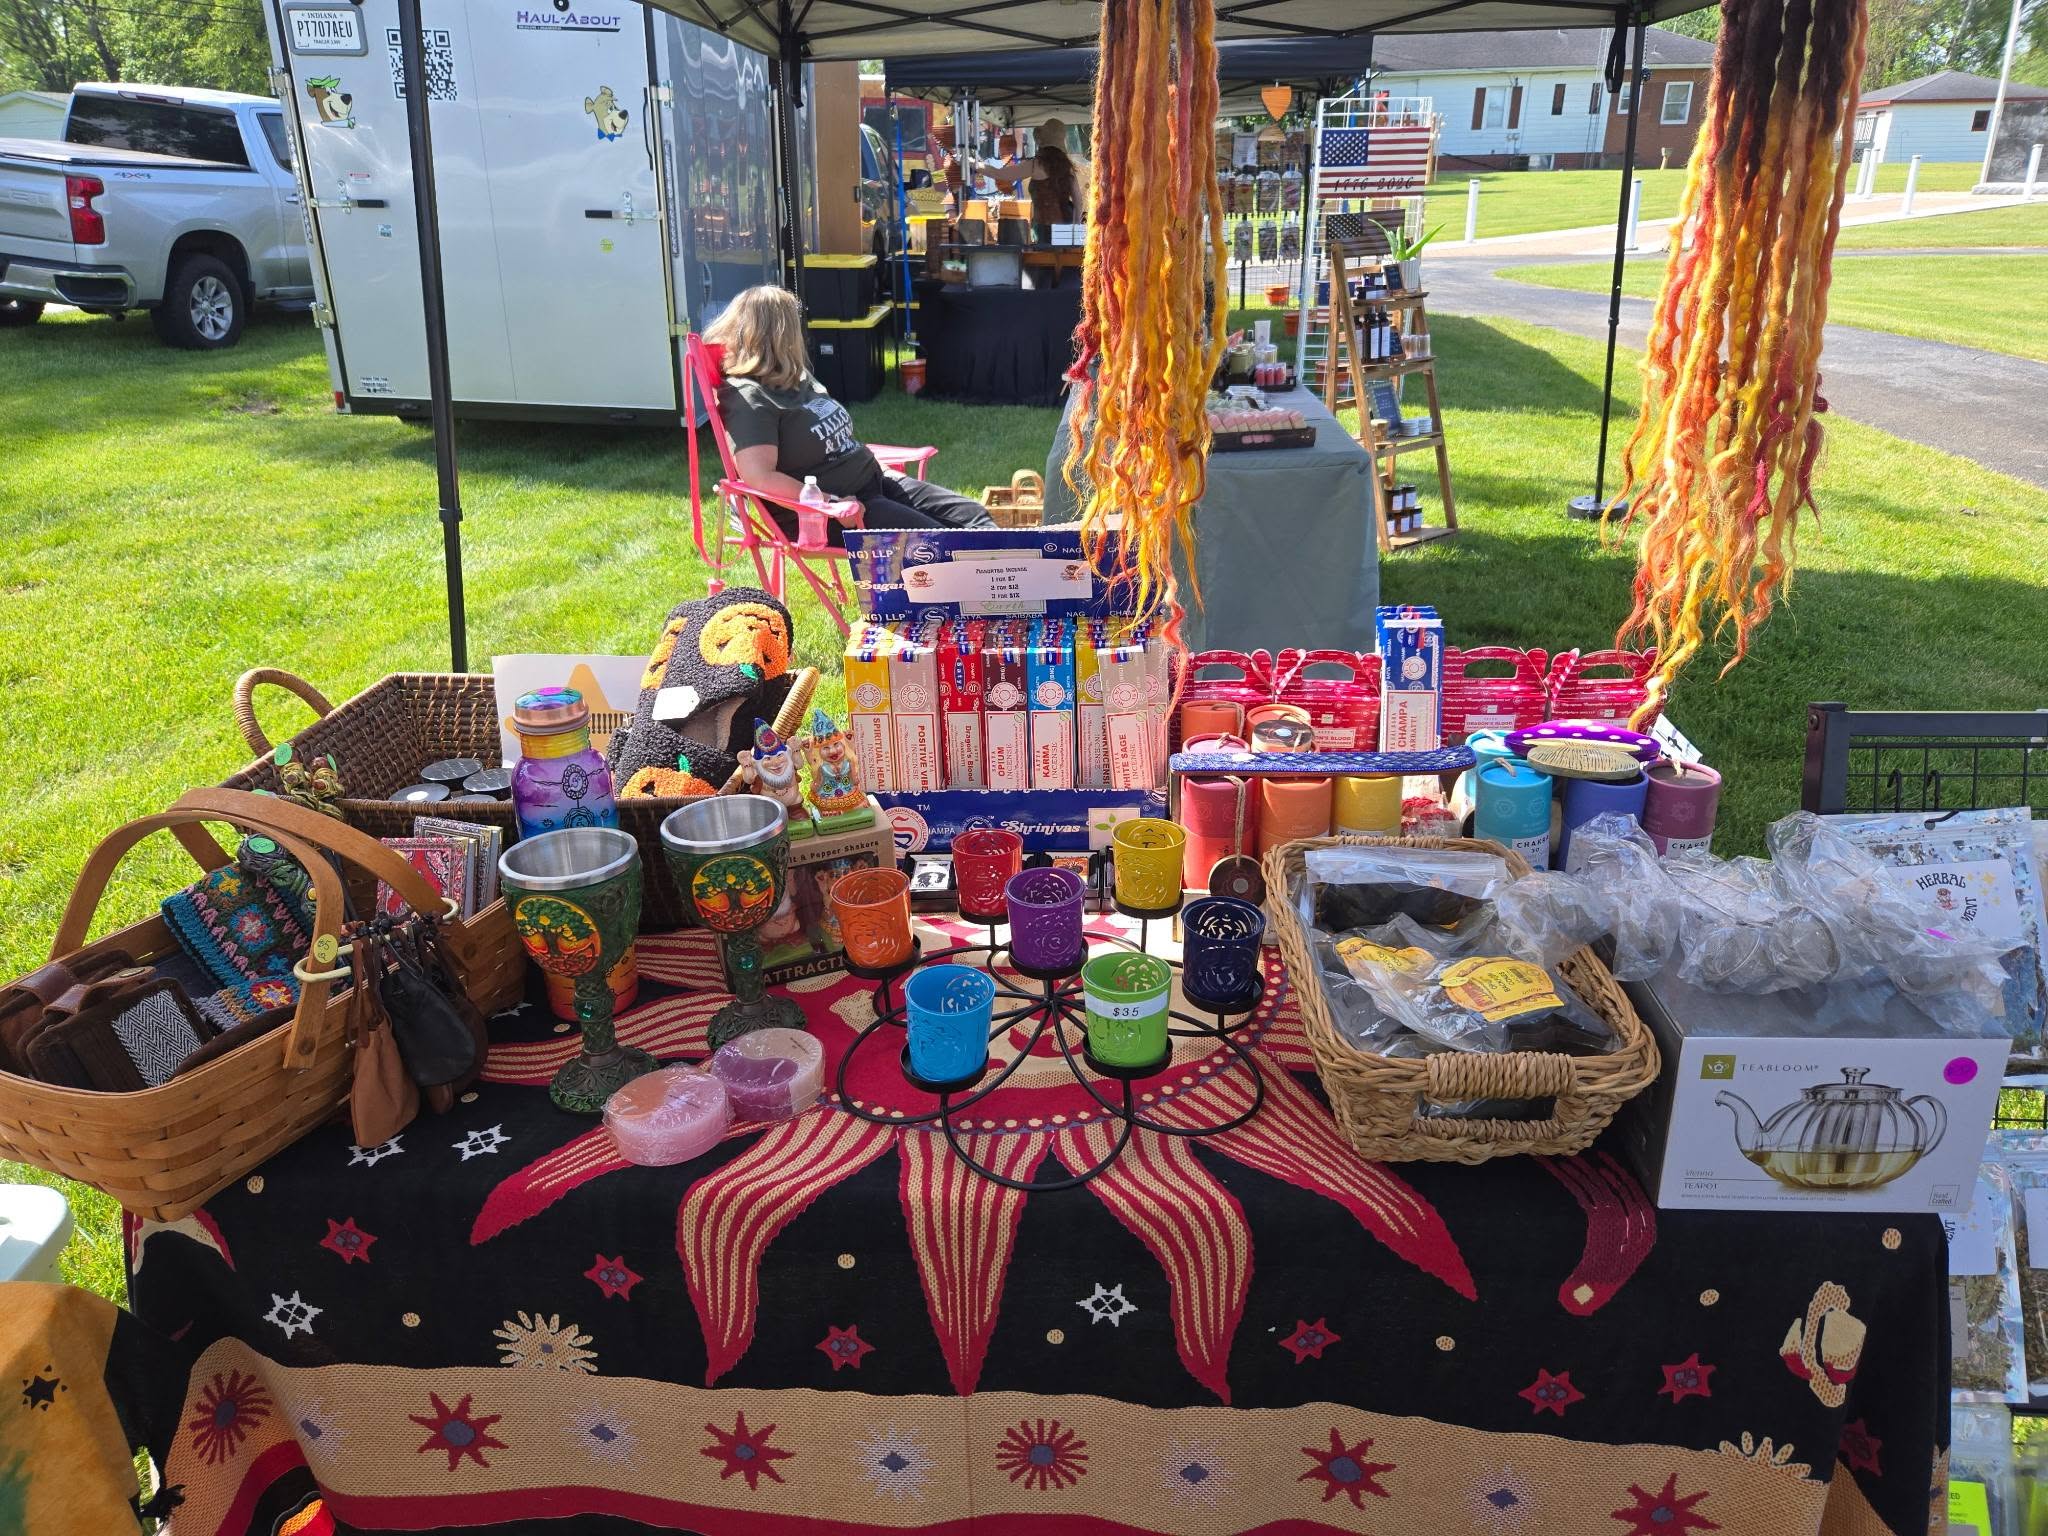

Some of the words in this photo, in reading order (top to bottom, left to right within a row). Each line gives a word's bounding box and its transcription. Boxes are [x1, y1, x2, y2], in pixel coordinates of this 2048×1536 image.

[297, 21, 352, 37] PT707AEU
[517, 11, 620, 25] HAUL-ABOUT
[810, 408, 851, 441] TALLO
[1398, 700, 1408, 748] CHAMPA
[873, 717, 883, 764] SPIRITUAL
[917, 725, 927, 768] POSITIVE
[965, 725, 973, 758] Dragon's
[1119, 734, 1128, 758] SAGE
[997, 746, 1005, 777] OPIUM
[1042, 744, 1050, 778] KARMA
[1001, 821, 1081, 835] Shrinivas
[1916, 872, 1966, 890] HERBAL
[763, 956, 844, 984] ATTRACTI
[1113, 1007, 1140, 1017] $35
